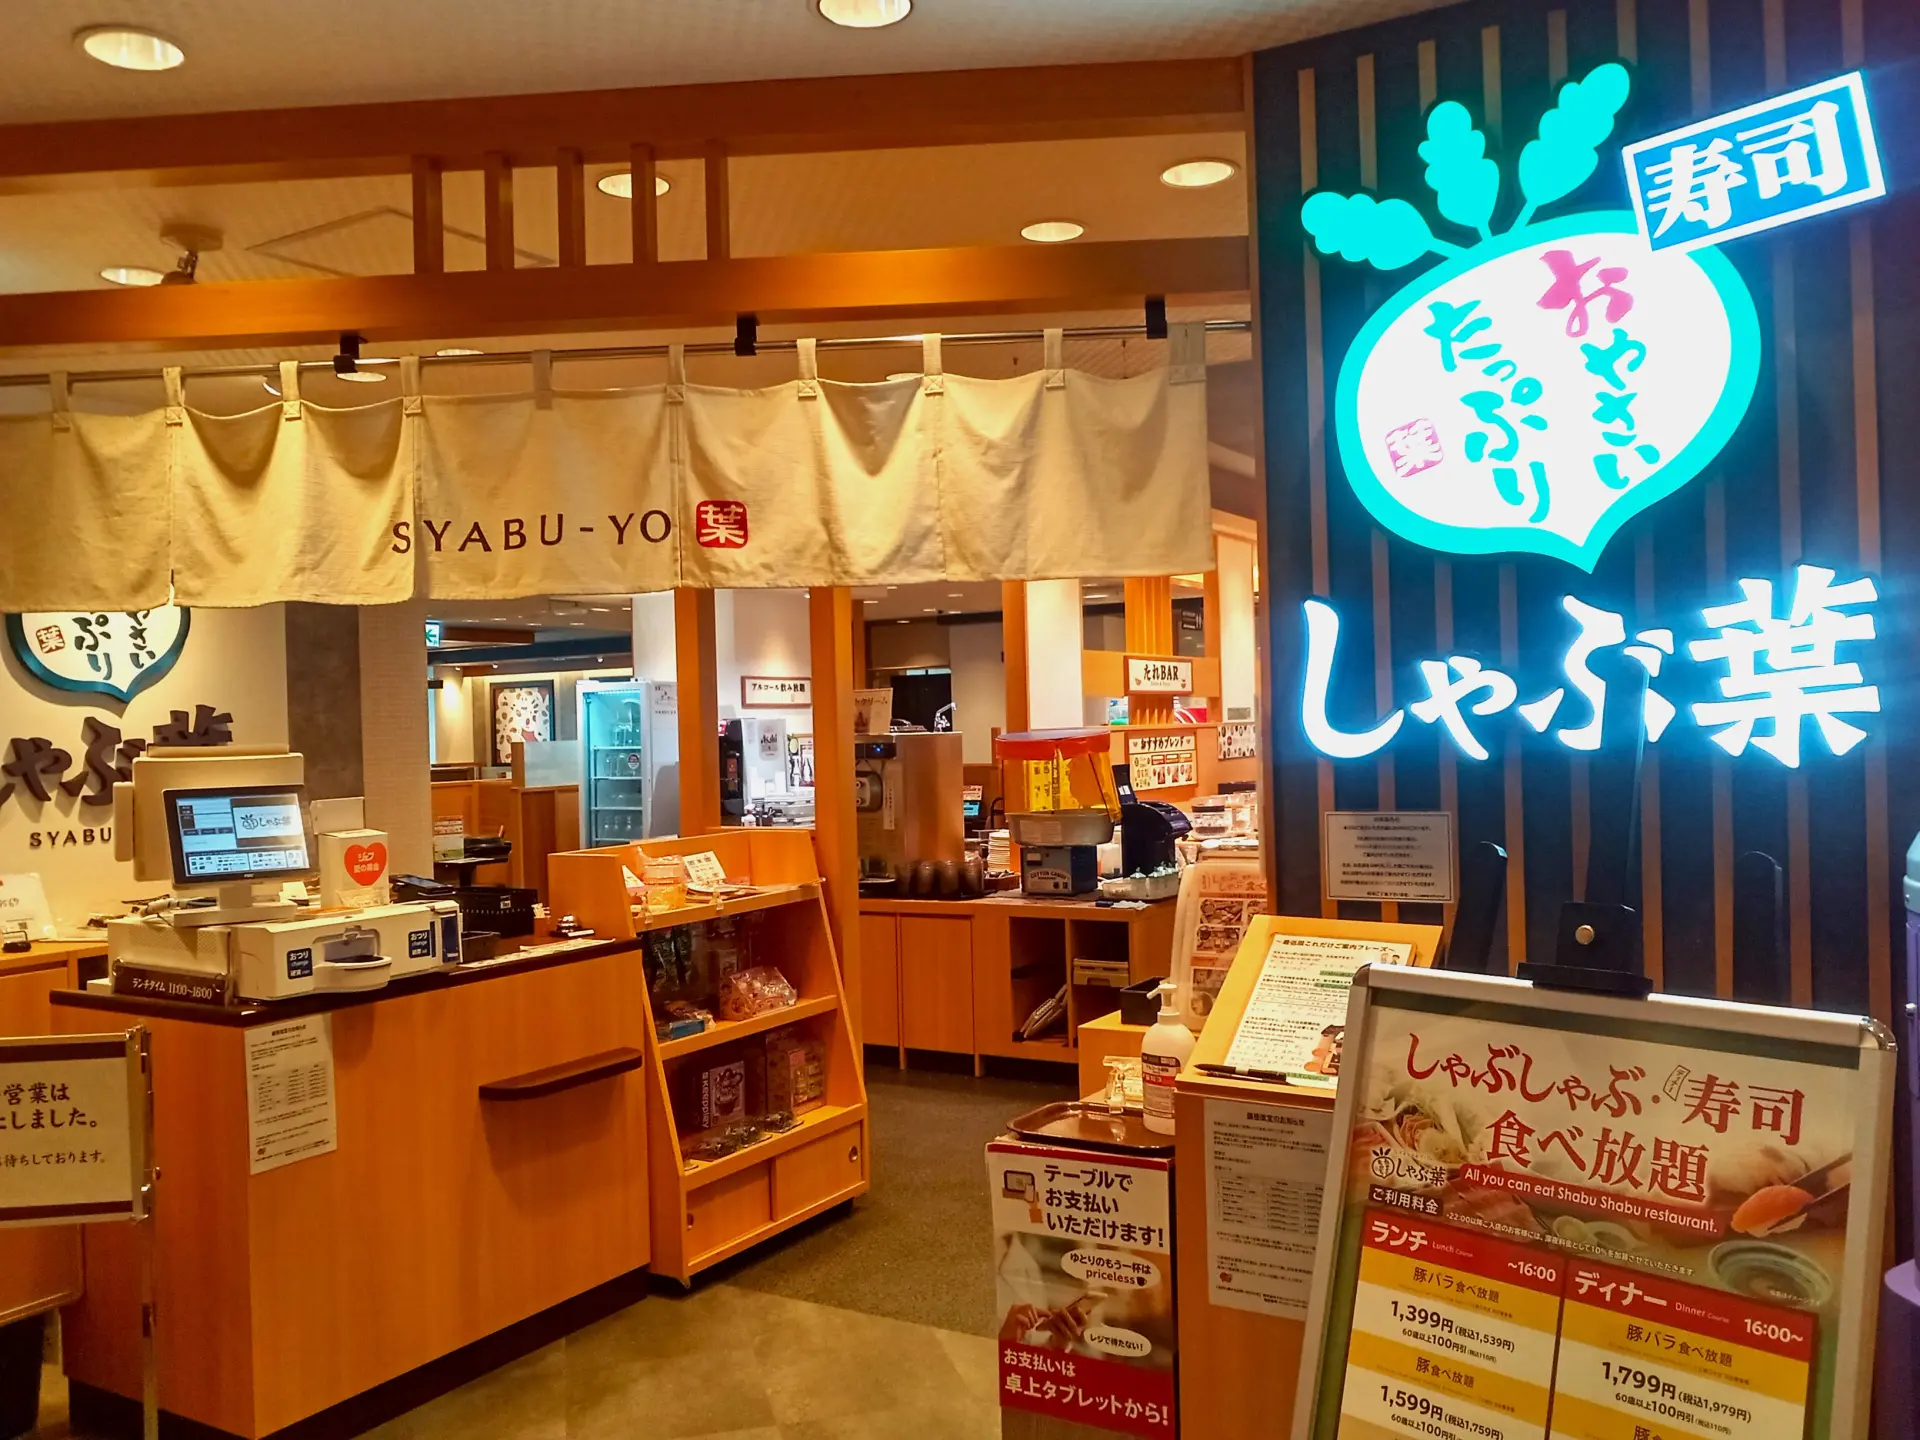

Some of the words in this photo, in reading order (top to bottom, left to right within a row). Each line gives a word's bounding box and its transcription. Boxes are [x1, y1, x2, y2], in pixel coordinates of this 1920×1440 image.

[1645, 101, 1848, 239] 寿司
[1537, 250, 1660, 489] おやさい
[1423, 299, 1550, 523] たっぷり
[1385, 418, 1444, 478] 葉
[391, 509, 672, 555] SYABU-YO
[697, 502, 747, 547] 葉
[35, 625, 65, 654] 葉
[1143, 664, 1179, 680] たれBAR
[1302, 564, 1881, 768] しゃぶ葉
[289, 951, 309, 961] おつり
[132, 978, 166, 992] ランチタイム
[0, 1150, 105, 1168] 待ちしております。
[1396, 1158, 1446, 1187] しゃぶ葉
[1485, 1109, 1709, 1203] 食べ放題
[1044, 1164, 1133, 1193] テーブルで
[1045, 1187, 1119, 1214] お支払い
[1372, 1188, 1438, 1215] ご利用料金
[1464, 1167, 1480, 1182] All
[1482, 1173, 1504, 1188] you
[1506, 1179, 1531, 1193] can
[1534, 1183, 1555, 1198] eat
[1557, 1188, 1597, 1207] Shabu
[1600, 1196, 1641, 1216] Shabu
[1644, 1208, 1718, 1233] restaurant.
[1371, 1220, 1428, 1252] ランチ
[1432, 1241, 1454, 1254] Lunch
[1070, 1252, 1151, 1276] ゆとりのもう一杯は
[1086, 1266, 1136, 1286] priceless
[1413, 1266, 1500, 1304] 豚バラ食べ放題
[1574, 1270, 1668, 1306] ディナー
[1391, 1300, 1454, 1334] 1,399円
[1674, 1301, 1706, 1318] Dinner
[1626, 1323, 1733, 1368] 豚バラ食べ放題
[1003, 1348, 1076, 1378] お支払いは
[1416, 1356, 1475, 1389] 豚食べ放題
[1601, 1361, 1677, 1400] 1,799円
[1380, 1385, 1444, 1421] 1,599円
[1615, 1391, 1695, 1424] 60歳以上100円引
